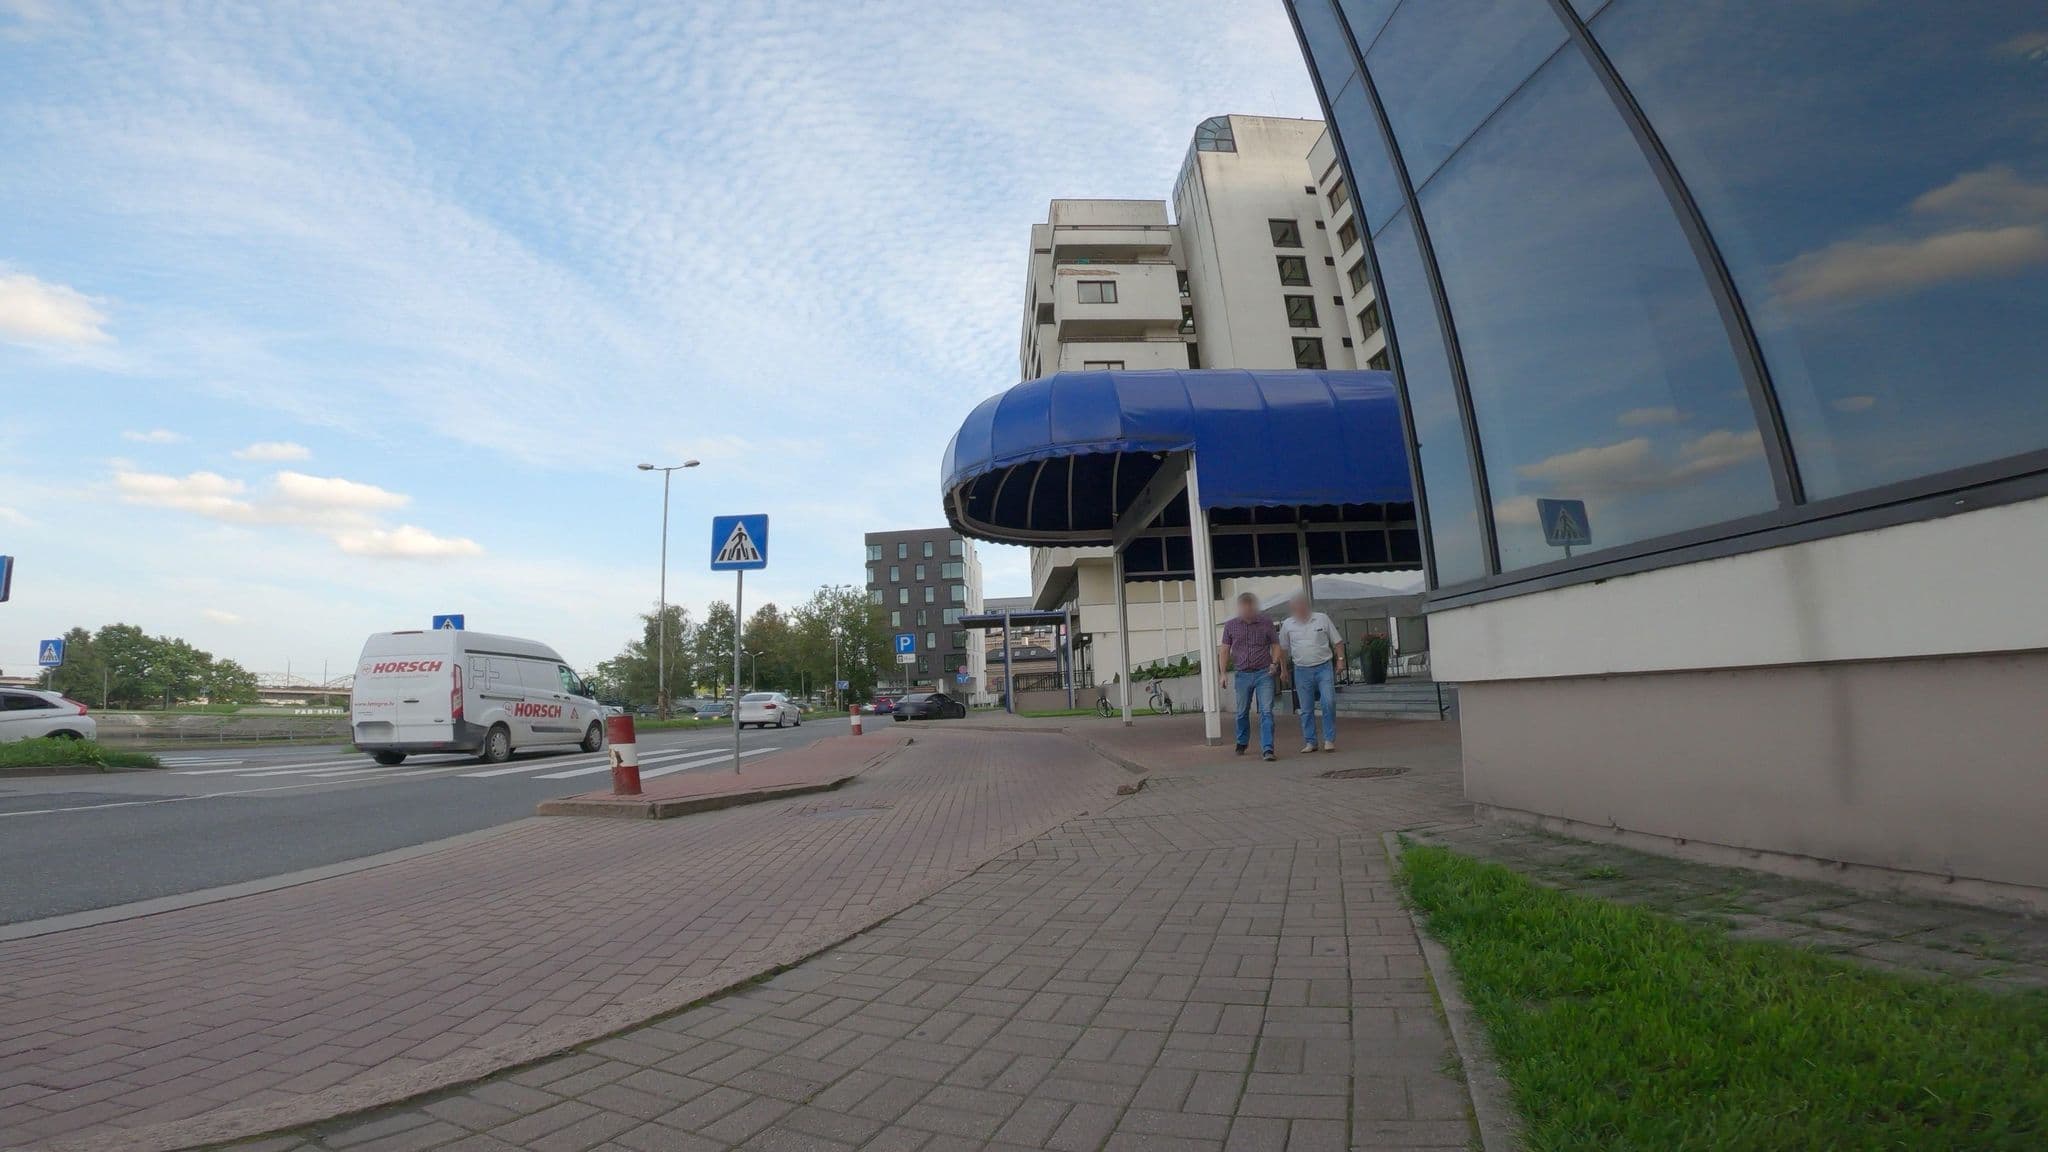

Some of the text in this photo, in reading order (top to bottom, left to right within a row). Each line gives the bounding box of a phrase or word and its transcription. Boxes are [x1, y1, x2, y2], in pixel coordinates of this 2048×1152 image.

[900, 636, 911, 651] P
[372, 661, 443, 674] HORSCH
[514, 703, 561, 718] HORSCH
